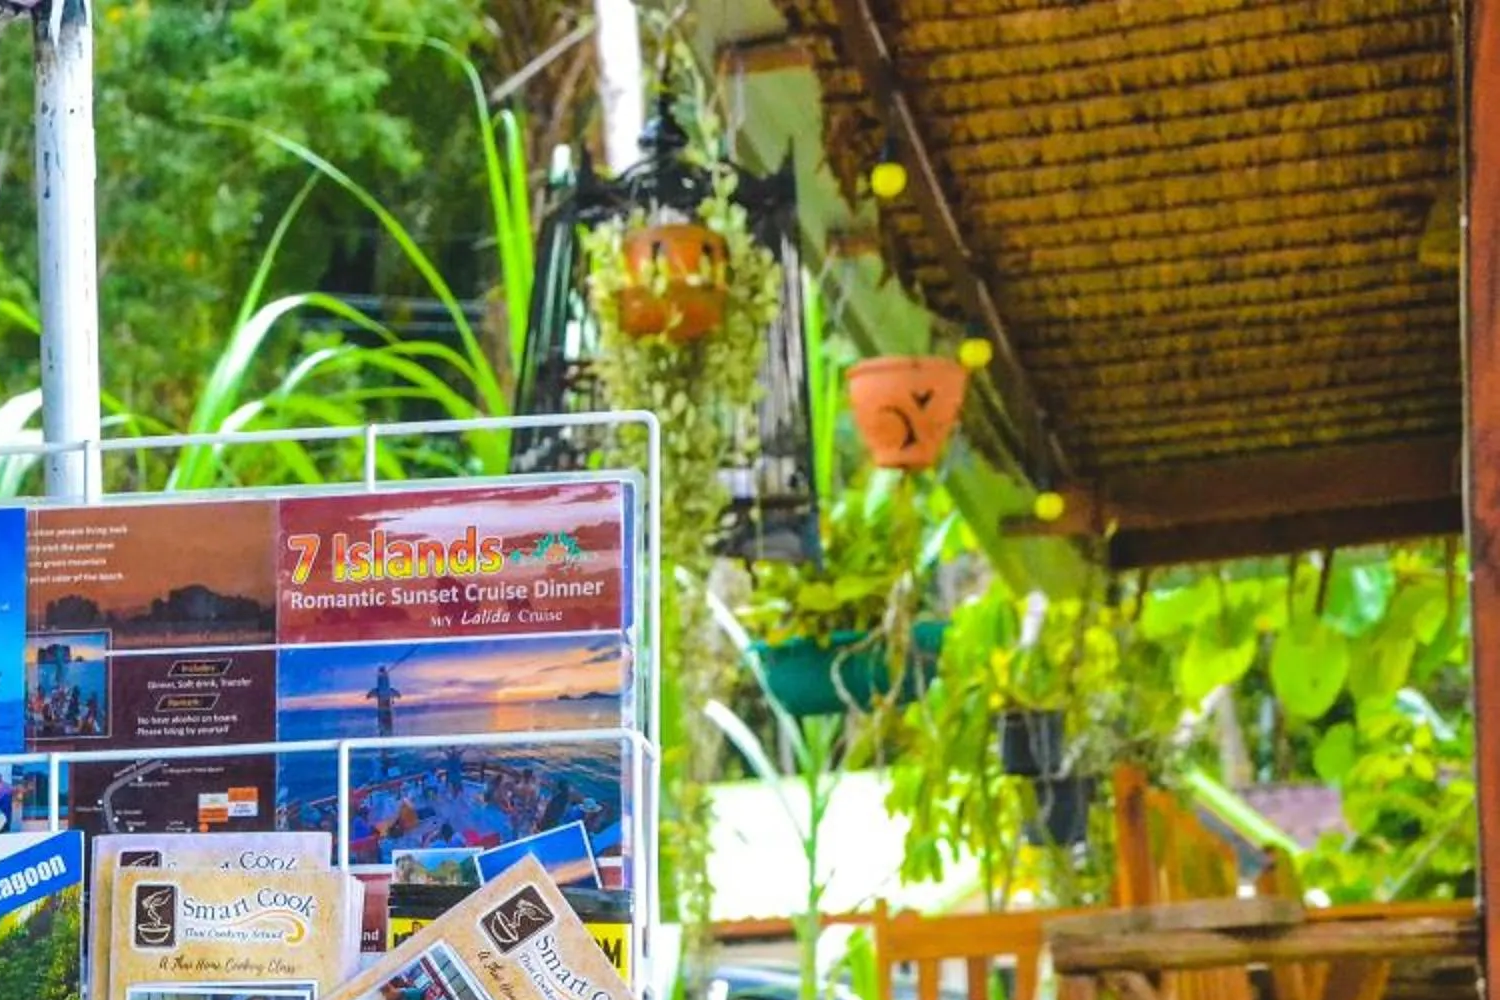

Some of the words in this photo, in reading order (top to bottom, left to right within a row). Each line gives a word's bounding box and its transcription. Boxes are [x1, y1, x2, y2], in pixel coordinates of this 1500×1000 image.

[287, 534, 321, 585] 7
[331, 525, 505, 583] Islands
[290, 587, 386, 610] Romantic
[391, 586, 459, 606] Sunset
[465, 582, 528, 602] Cruise
[534, 579, 605, 599] Dinner
[461, 609, 511, 625] Lalida
[517, 609, 563, 623] Cruise
[182, 896, 248, 921] Smart
[256, 887, 318, 918] Cook
[535, 935, 589, 996] Smart
